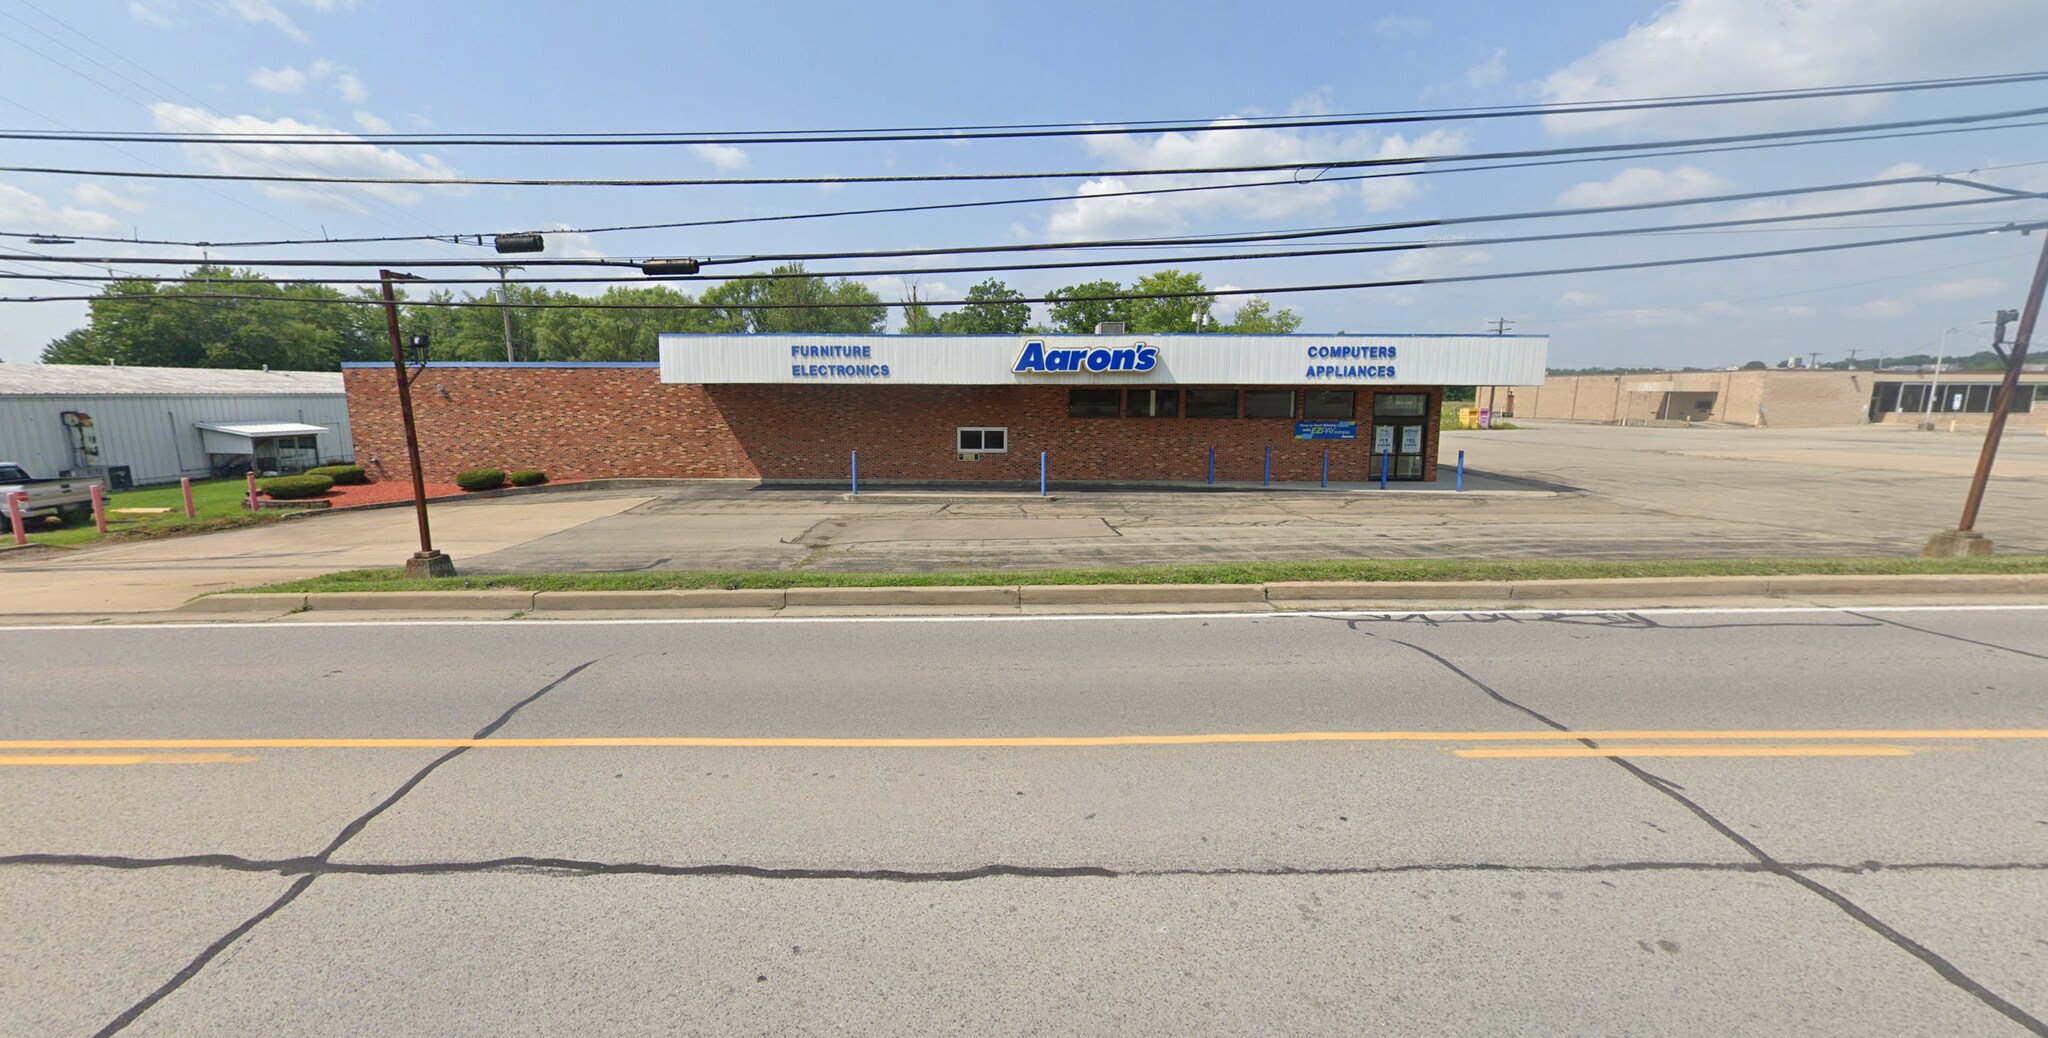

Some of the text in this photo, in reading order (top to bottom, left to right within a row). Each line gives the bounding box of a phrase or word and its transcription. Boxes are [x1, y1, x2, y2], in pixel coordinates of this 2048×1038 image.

[791, 345, 871, 358] FURNITURE
[1012, 341, 1159, 372] Aaron's
[1307, 346, 1397, 358] COMPUTERS
[791, 364, 890, 377] ELECTRONICS
[1305, 365, 1396, 378] APPLIANCES
